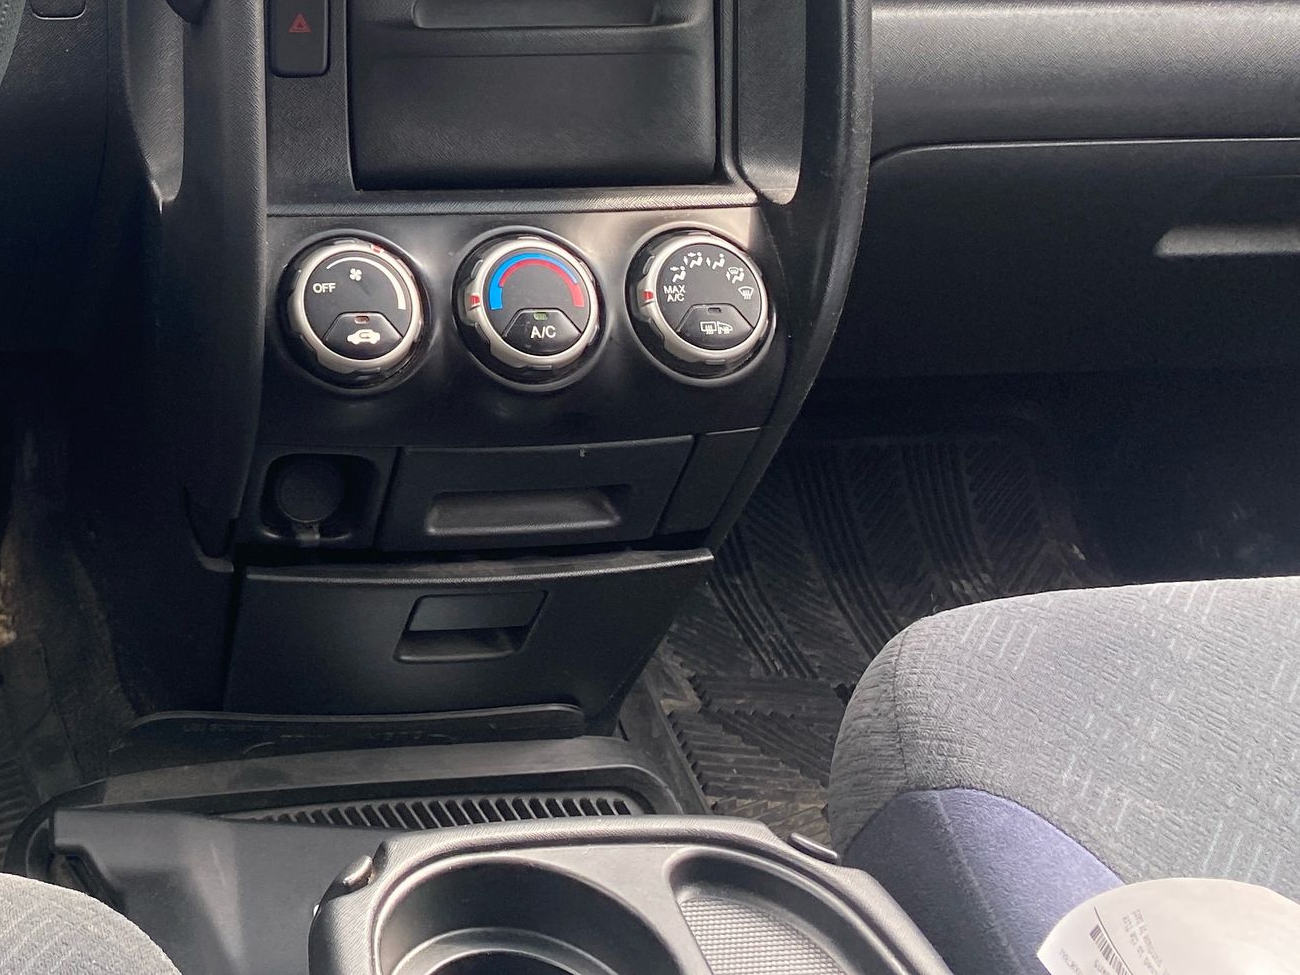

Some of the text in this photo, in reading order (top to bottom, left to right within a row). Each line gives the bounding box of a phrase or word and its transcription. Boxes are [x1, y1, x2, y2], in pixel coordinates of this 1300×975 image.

[312, 282, 337, 293] OFF
[663, 285, 686, 294] MAX
[666, 293, 685, 302] A/C
[530, 325, 557, 339] A/C
